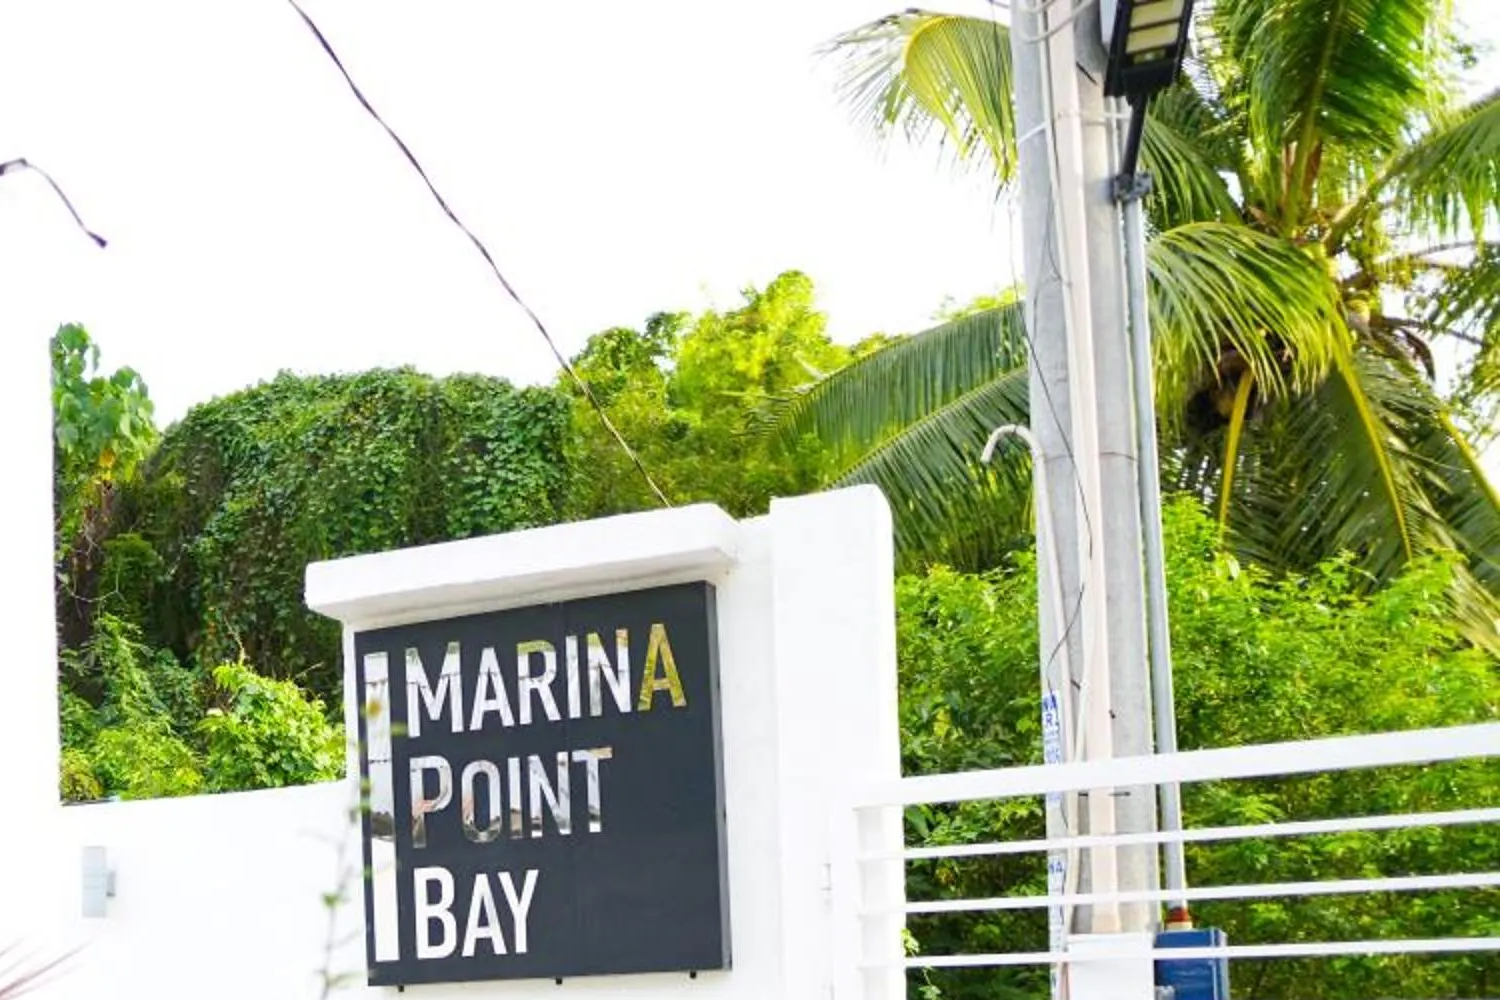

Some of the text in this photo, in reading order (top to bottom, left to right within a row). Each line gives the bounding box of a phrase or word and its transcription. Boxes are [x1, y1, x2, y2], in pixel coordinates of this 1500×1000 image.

[405, 623, 687, 738] MARINA
[409, 746, 612, 848] POINT
[413, 866, 539, 960] BAY
